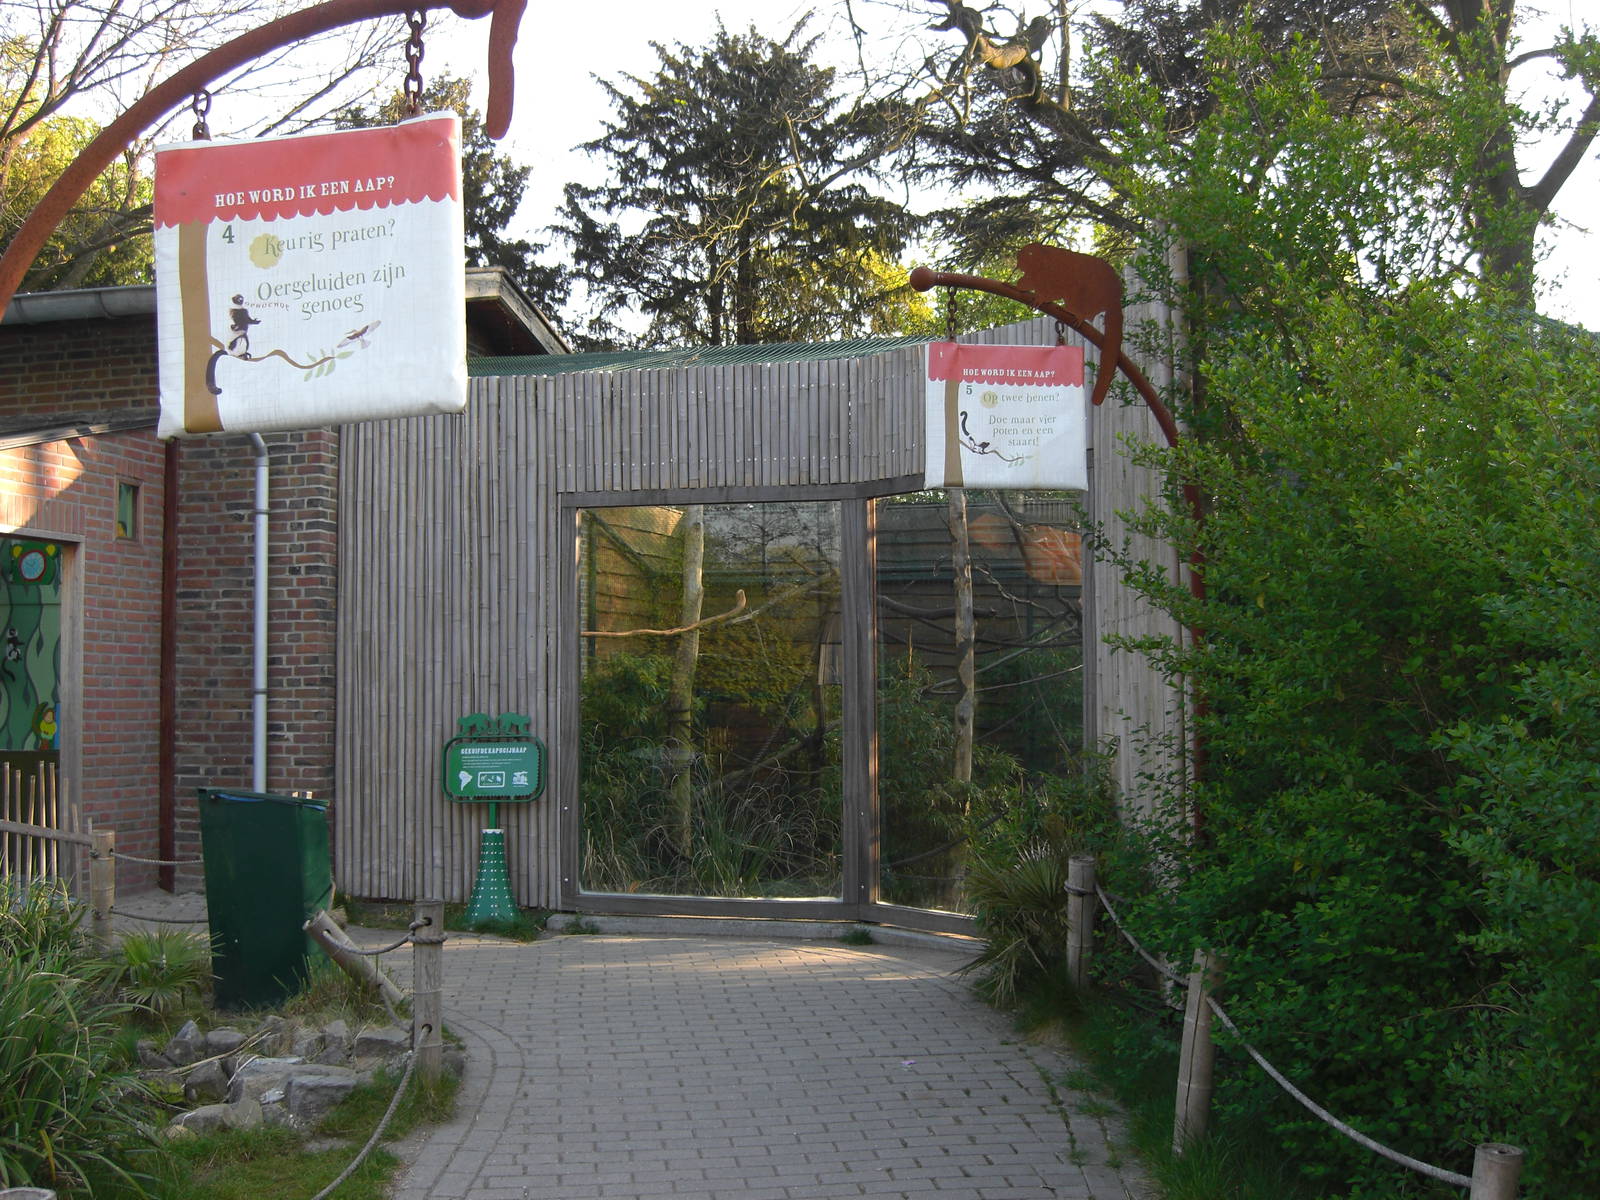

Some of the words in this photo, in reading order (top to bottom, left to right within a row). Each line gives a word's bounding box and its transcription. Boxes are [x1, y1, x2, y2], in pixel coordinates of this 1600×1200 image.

[215, 192, 245, 207] HOE
[249, 187, 295, 203] WORD
[300, 185, 317, 199] IK
[320, 180, 350, 196] EEN
[354, 176, 395, 192] AAP?
[222, 225, 235, 244] 4
[264, 231, 325, 257] Keurig
[332, 219, 396, 250] praten?
[257, 271, 366, 301] Oergeluiden
[372, 263, 405, 288] zijn
[301, 293, 364, 321] genoeg
[963, 368, 980, 376] HOE
[981, 369, 1005, 377] WORD
[1006, 369, 1015, 377] IK
[1034, 370, 1056, 378] AAP?
[966, 385, 973, 395] 5
[983, 393, 998, 404] Op
[1001, 394, 1023, 402] twee
[989, 415, 1008, 425] Doe
[1039, 415, 1057, 424] vier
[993, 428, 1018, 437] poten
[1008, 437, 1039, 447] staart!
